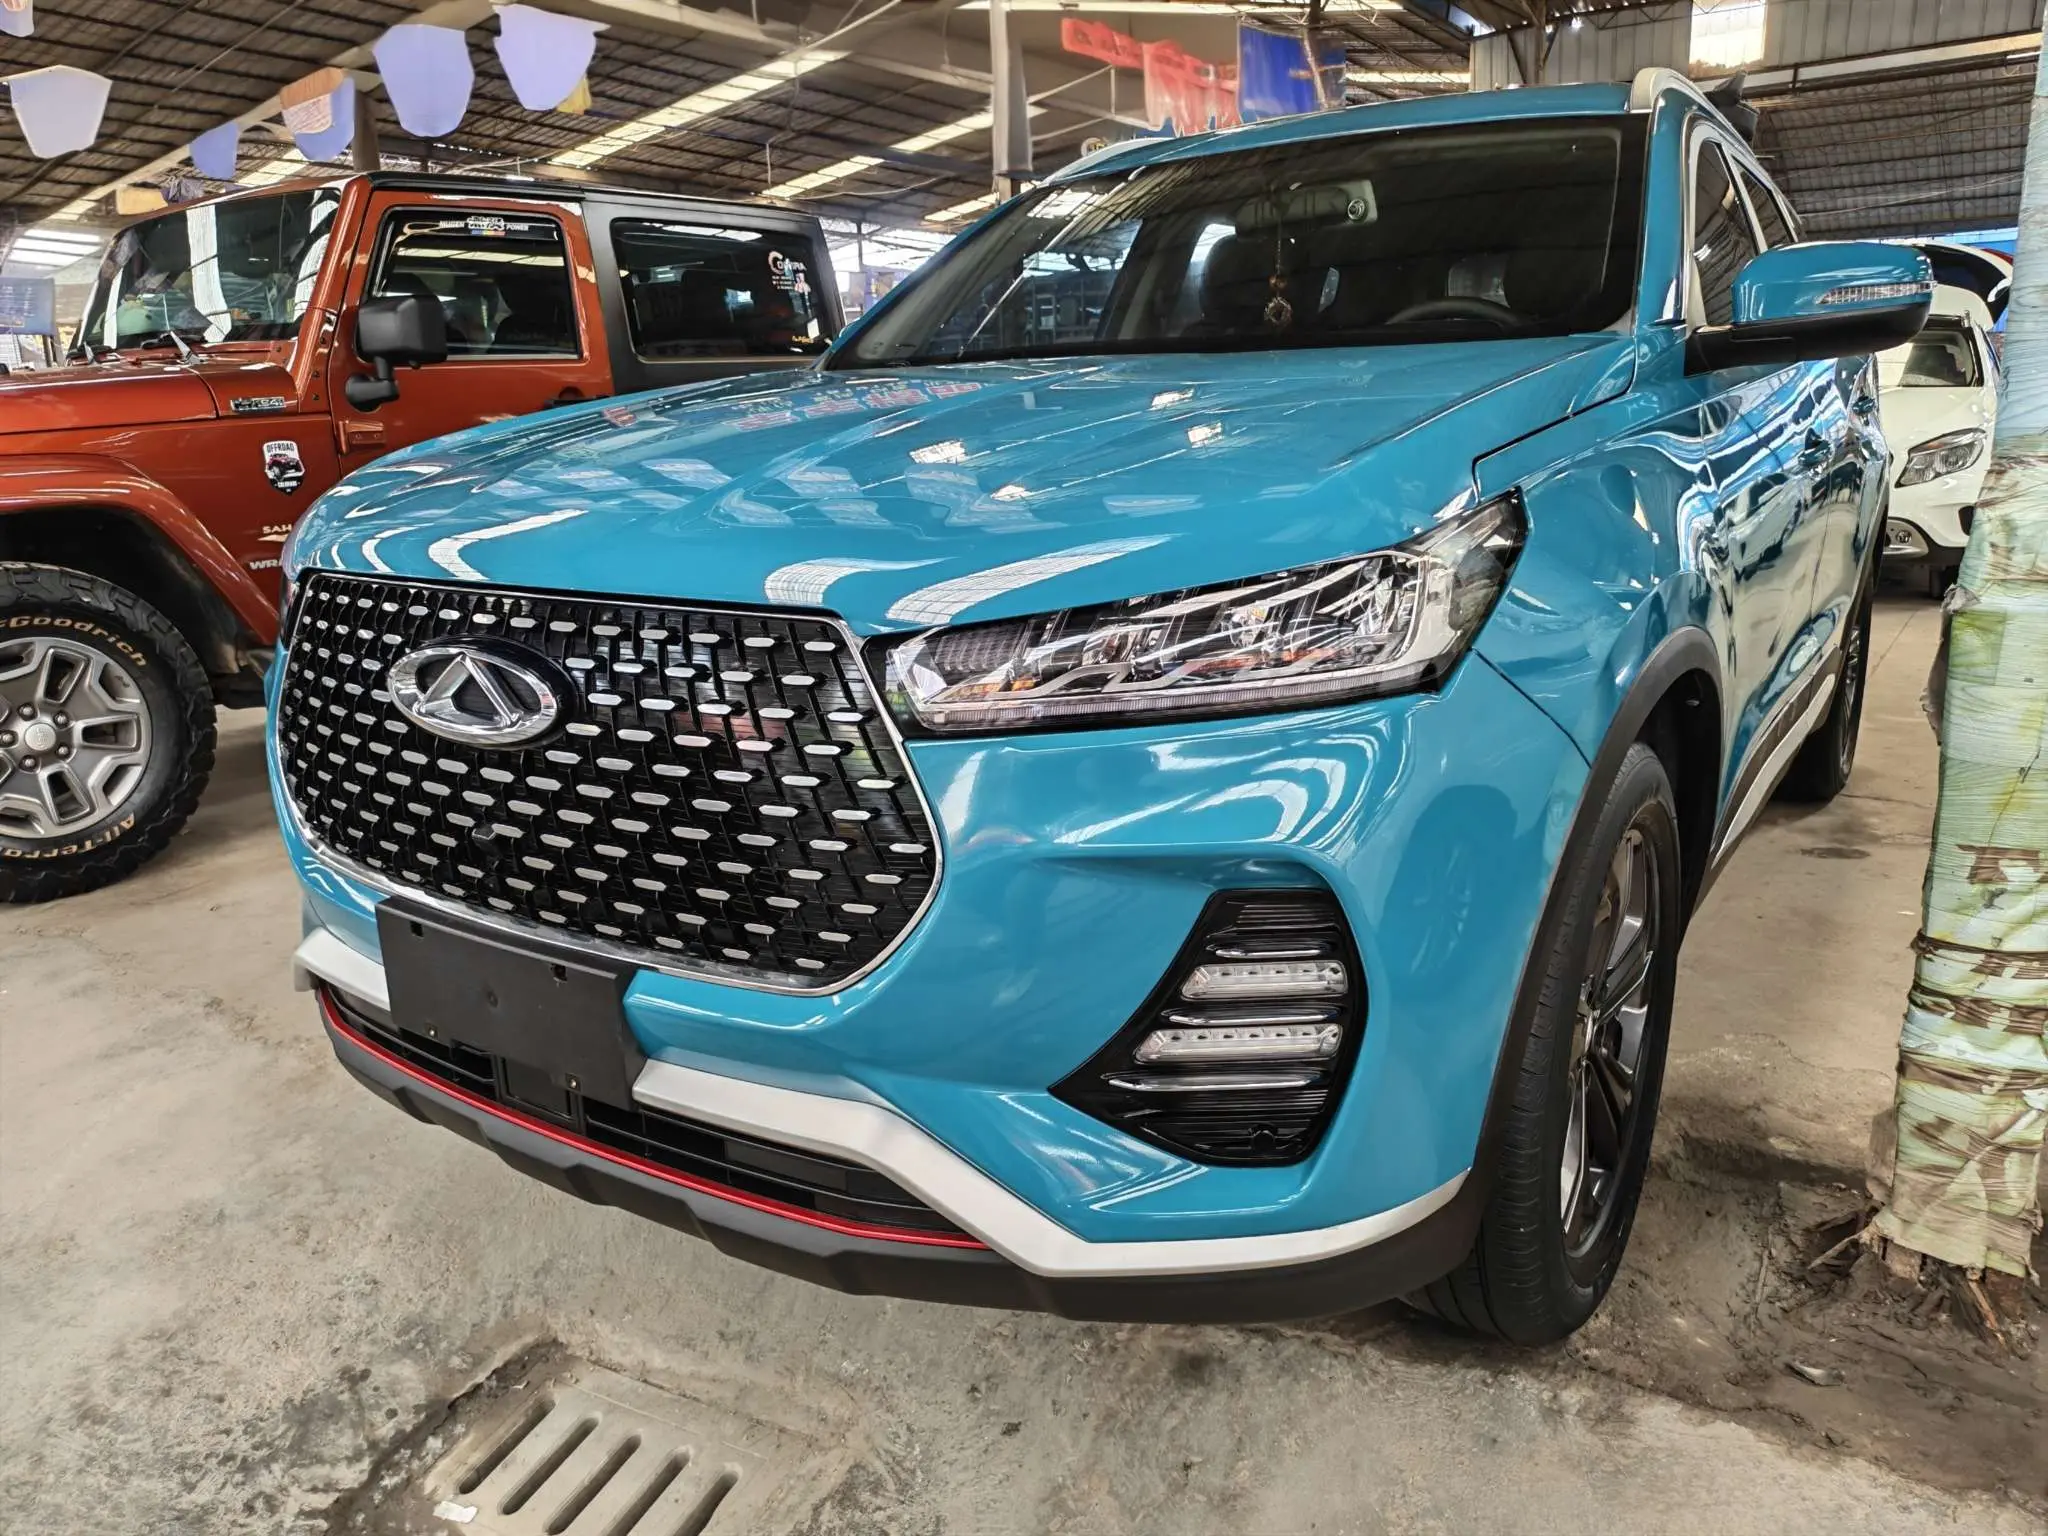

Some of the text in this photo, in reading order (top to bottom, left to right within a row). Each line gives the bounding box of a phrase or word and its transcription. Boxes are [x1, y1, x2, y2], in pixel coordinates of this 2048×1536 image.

[506, 223, 529, 231] POWER
[266, 442, 295, 453] OFFROAD
[0, 811, 135, 859] All-Terra
